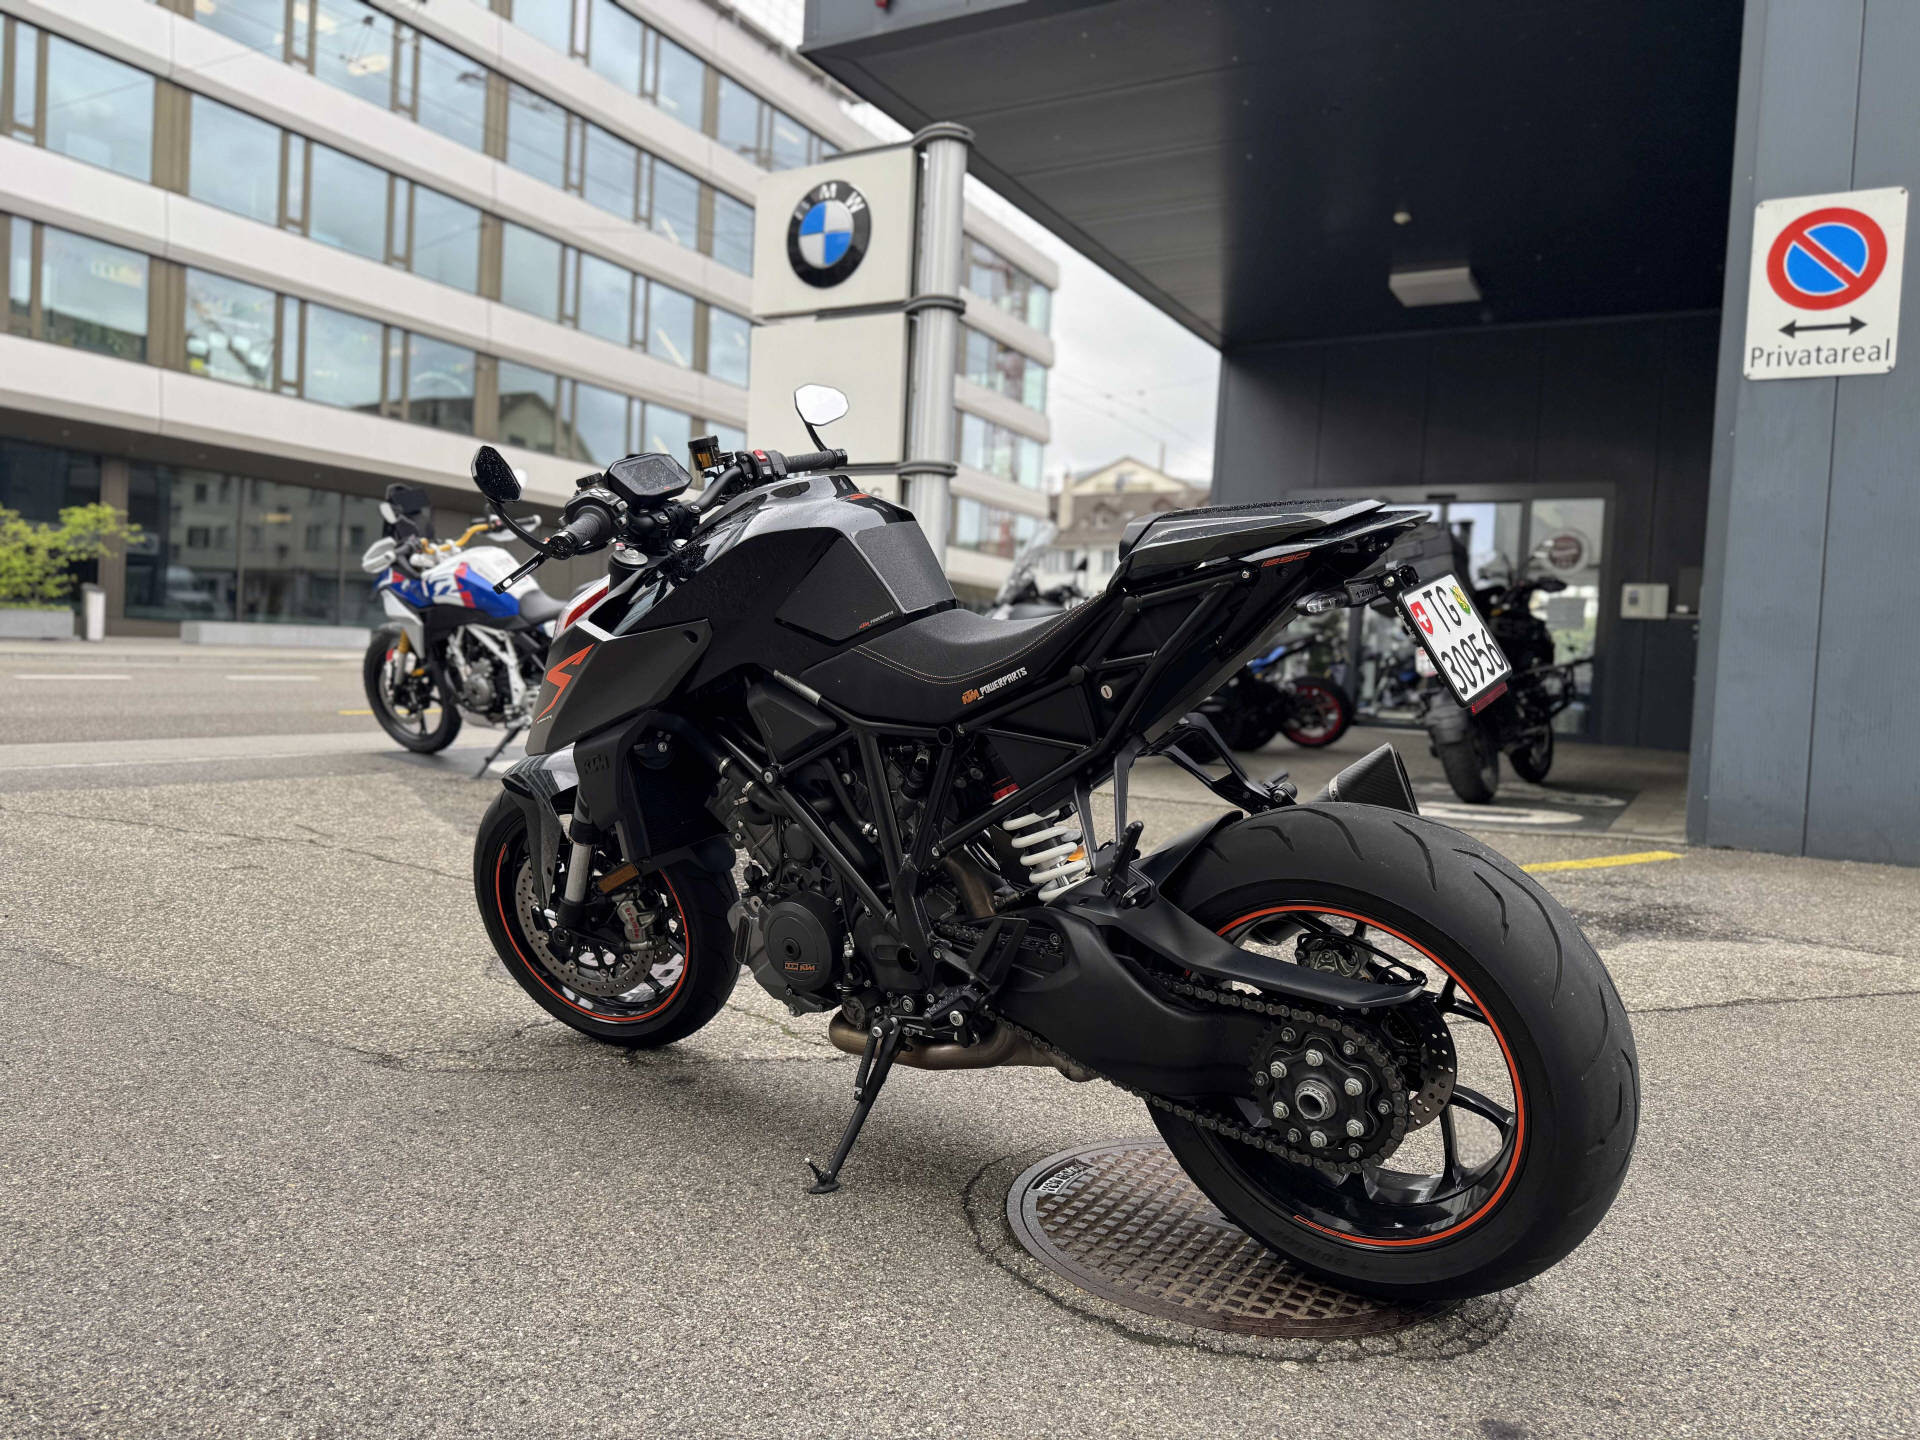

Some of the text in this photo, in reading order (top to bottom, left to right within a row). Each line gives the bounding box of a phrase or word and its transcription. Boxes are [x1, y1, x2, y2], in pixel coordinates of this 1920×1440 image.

[794, 183, 866, 220] BMW
[1751, 338, 1890, 368] Privatareal
[1422, 586, 1462, 633] TG
[1441, 628, 1505, 695] 30956
